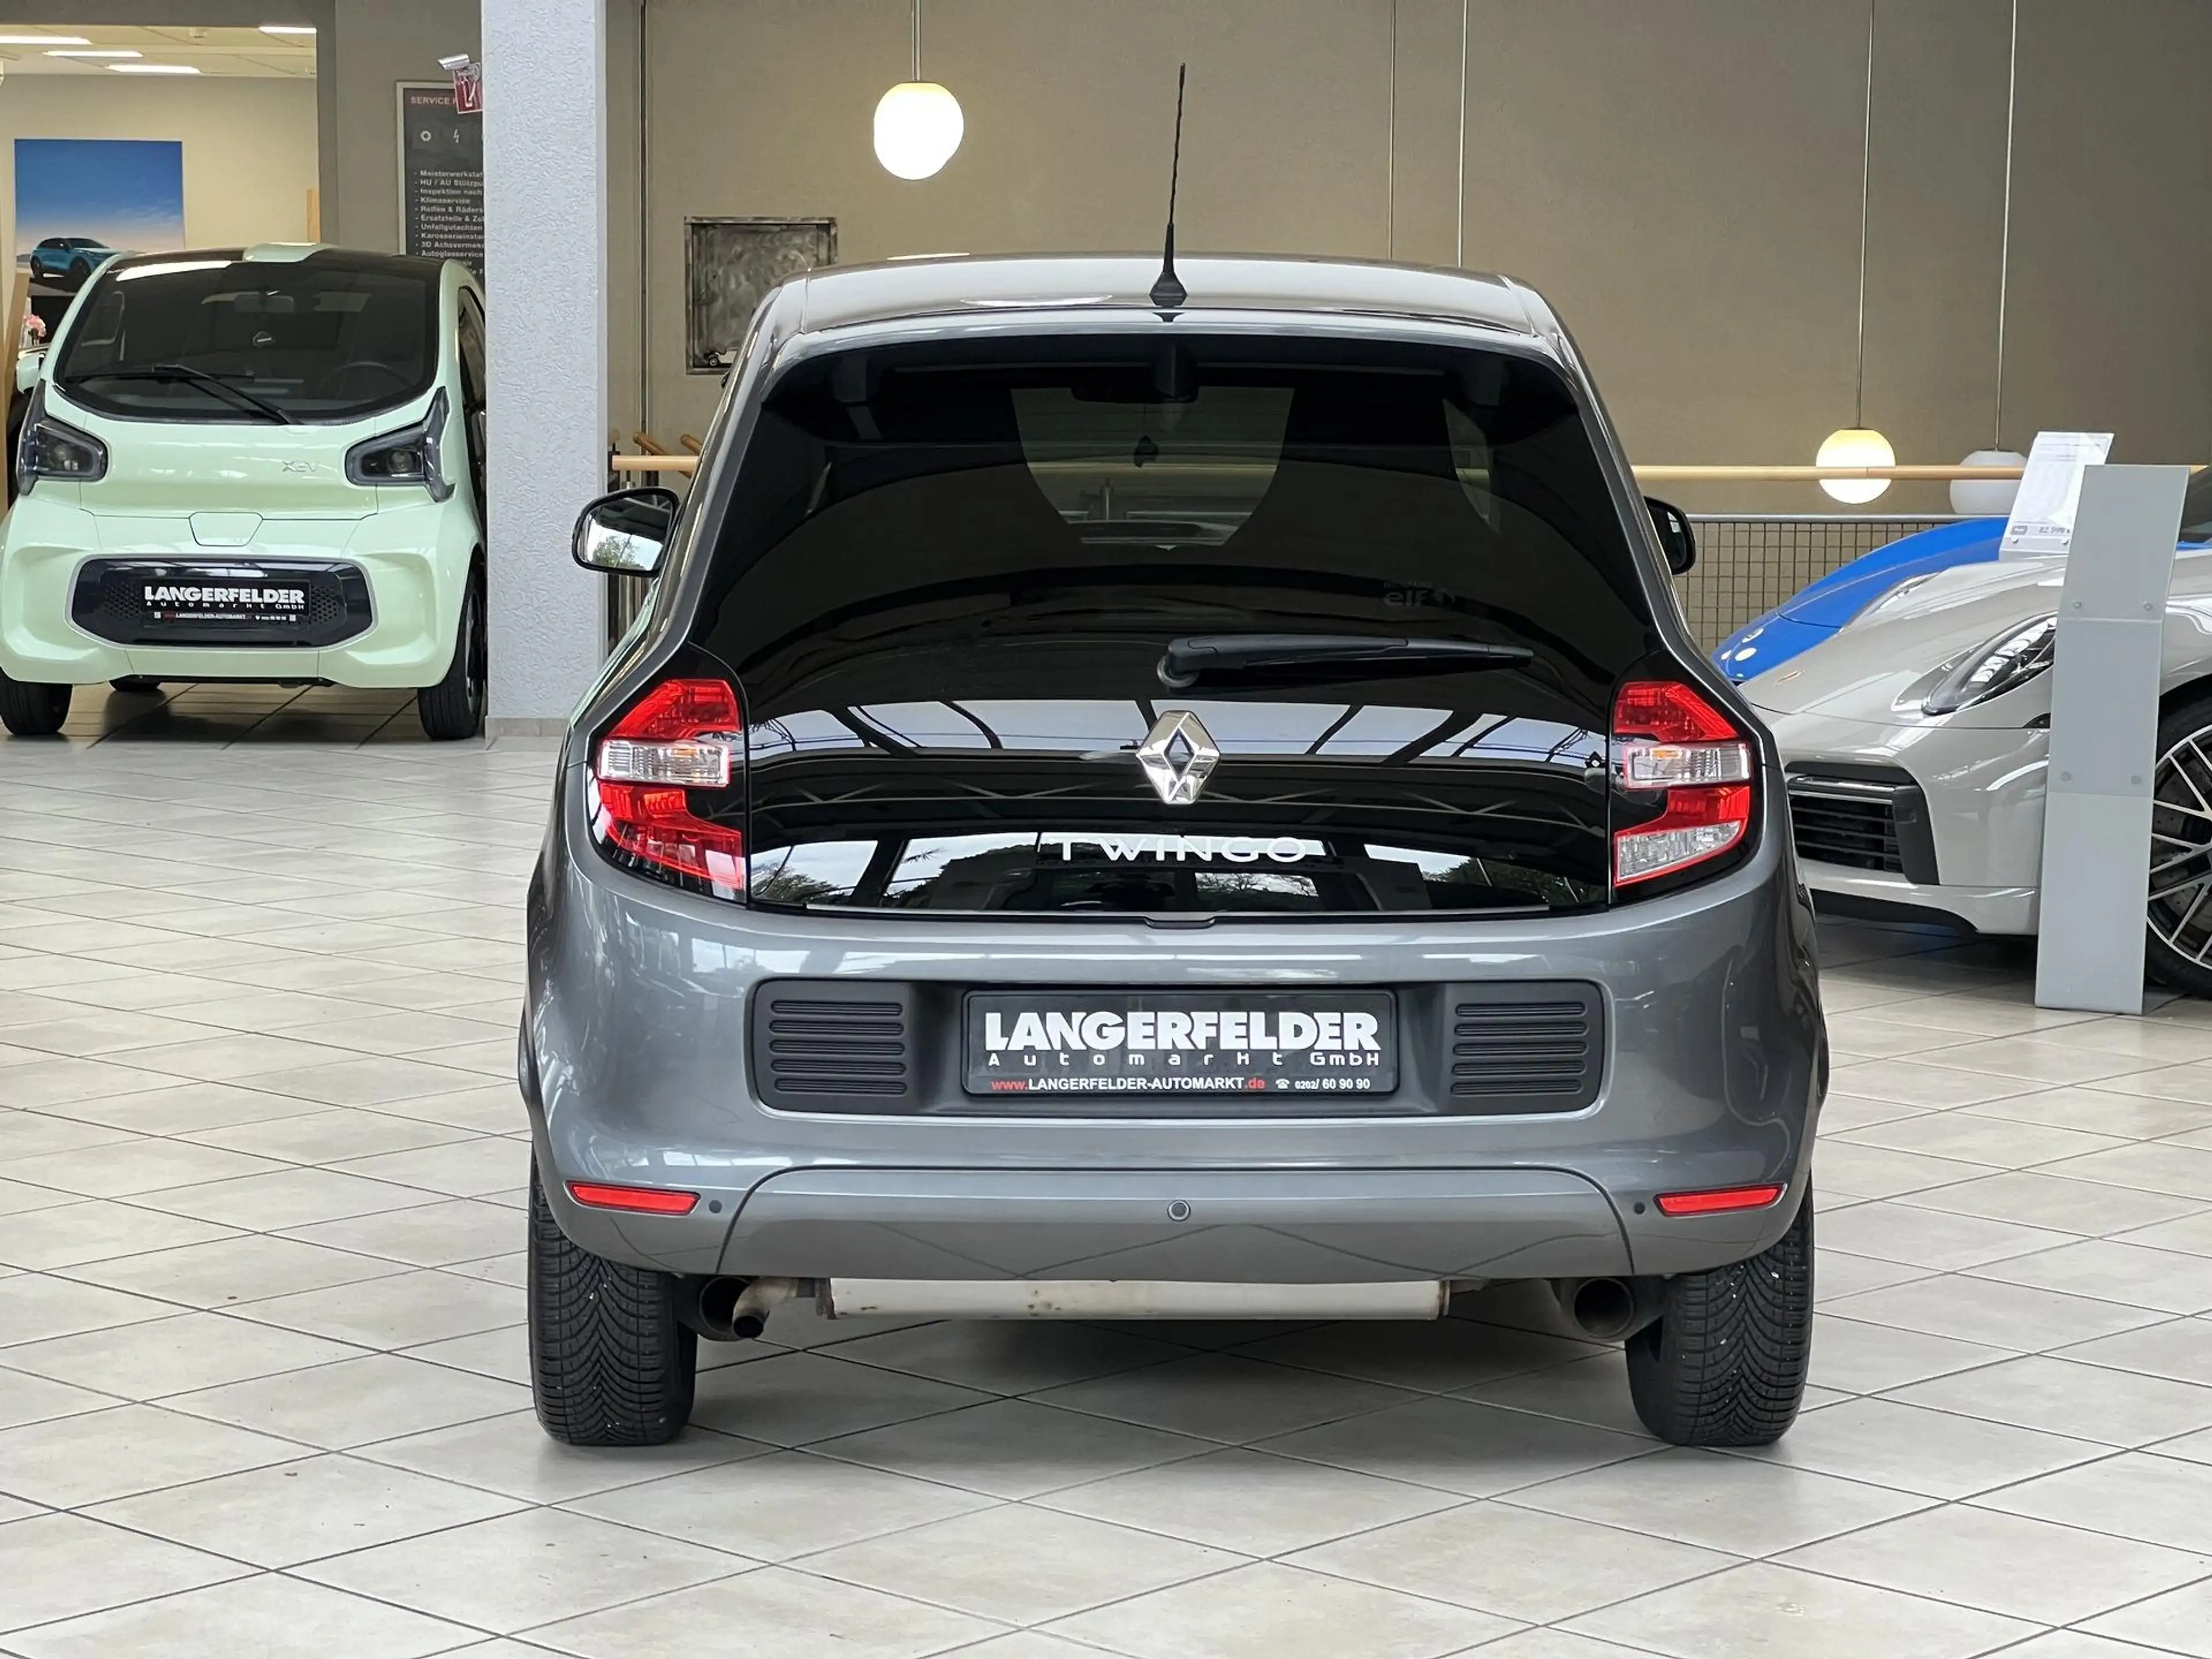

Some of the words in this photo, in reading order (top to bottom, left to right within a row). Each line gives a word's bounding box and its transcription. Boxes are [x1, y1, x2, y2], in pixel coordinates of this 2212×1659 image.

[410, 96, 449, 105] SERVICE
[145, 586, 305, 604] LANGERFELDER
[1048, 836, 1306, 862] TWINGO
[985, 1012, 1381, 1051] LANGERFELDER
[1309, 1052, 1380, 1066] GmbH
[991, 1077, 1265, 1090] www.LANGERFELDER-AUTOMARKT.de
[1295, 1078, 1320, 1090] 0202/
[1323, 1078, 1336, 1090] 60
[1339, 1078, 1354, 1090] 90
[1357, 1078, 1371, 1090] 90
